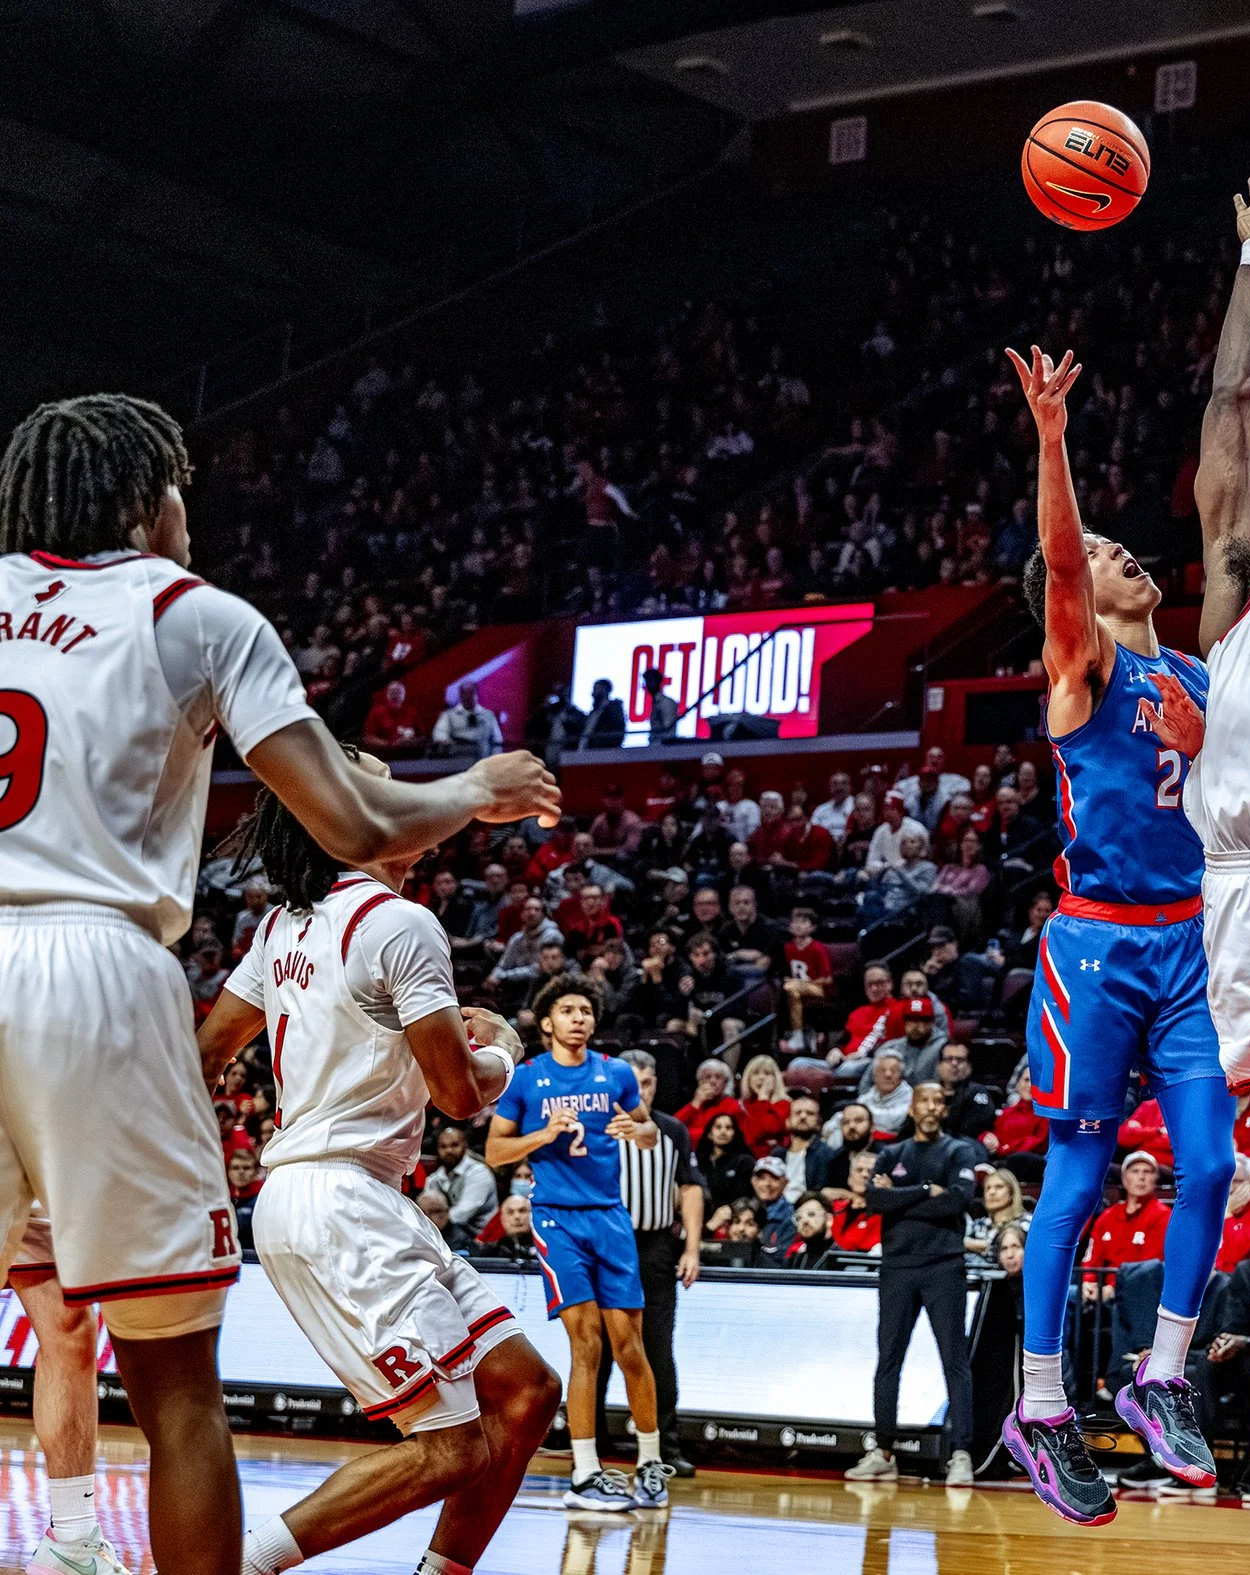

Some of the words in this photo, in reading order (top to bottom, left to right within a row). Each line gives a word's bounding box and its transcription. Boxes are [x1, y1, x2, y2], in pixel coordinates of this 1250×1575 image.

[1064, 131, 1131, 177] ELITE
[0, 611, 98, 654] RANT
[700, 626, 816, 716] LOUD!
[1156, 748, 1193, 809] 2
[273, 951, 315, 990] DAVIS
[541, 1093, 610, 1119] AMERICAN
[567, 1121, 588, 1157] 2
[208, 1208, 239, 1260] R
[372, 1344, 424, 1389] R
[796, 1432, 837, 1447] Prudential
